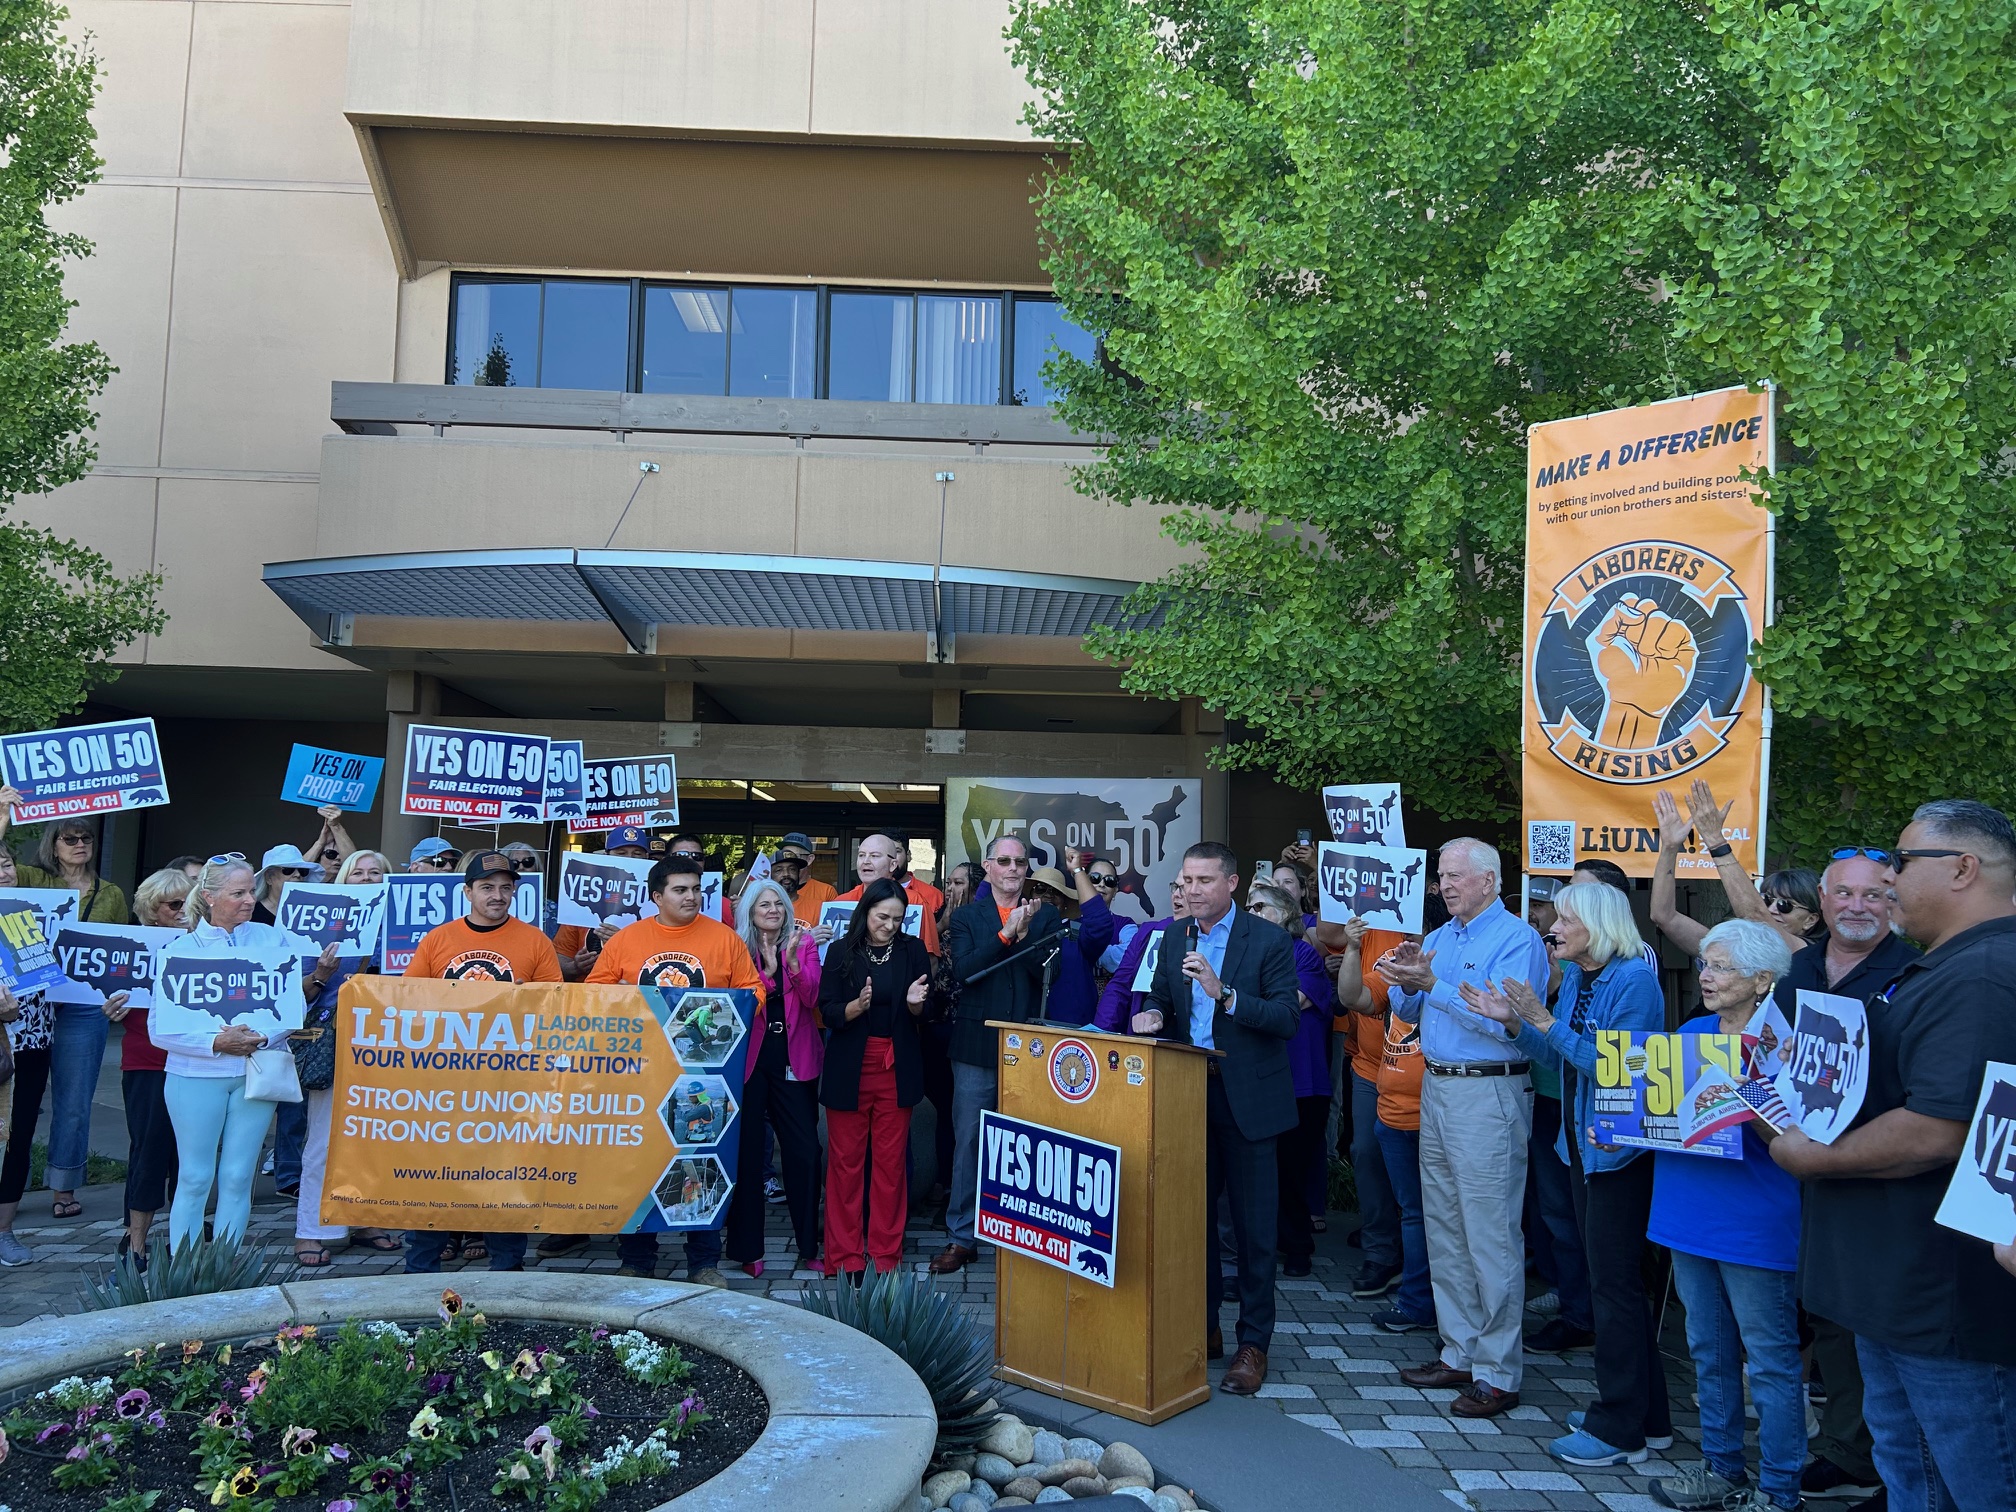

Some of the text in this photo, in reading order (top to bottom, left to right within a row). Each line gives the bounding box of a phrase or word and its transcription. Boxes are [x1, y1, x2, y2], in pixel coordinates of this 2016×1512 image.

[1536, 416, 1762, 488] MAKE A DIFFERENCE
[1539, 502, 1551, 512] by
[1554, 496, 1587, 511] getting
[1590, 486, 1635, 502] involved
[1638, 482, 1659, 494] and
[1663, 476, 1712, 490] building
[1546, 488, 1746, 524] with our union brothers and sisters!
[1578, 548, 1704, 592] LABORERS
[7, 730, 153, 782] YES ON 50
[311, 753, 366, 780] YES ON
[415, 734, 543, 782] YES ON 50
[548, 750, 578, 783] 50
[1574, 738, 1698, 777] RISING
[36, 772, 139, 795] FAIR ELECTIONS
[298, 774, 364, 802] PROP 50
[428, 780, 523, 796] FAIR ELECTIONS
[583, 763, 671, 798] ES ON 50
[18, 794, 118, 818] VOTE NOV. 4TH
[409, 797, 498, 815] VOTE NOV. 4TH
[586, 798, 659, 811] FAIR ELECTIONS
[573, 814, 642, 828] VOTE NOV. 4TH
[1347, 810, 1359, 821] ON
[1363, 807, 1388, 834] 50
[971, 818, 1160, 876] YS ON 50
[1582, 826, 1695, 854] LiUN!
[1679, 858, 1694, 868] the
[567, 874, 603, 902] YES
[606, 880, 621, 893] ON
[1324, 866, 1409, 901] YES ON 50
[287, 904, 372, 932] YES ON 50
[391, 882, 536, 926] YES O 0
[58, 946, 107, 978] YES
[112, 951, 129, 964] ON
[460, 952, 502, 964] LABORERS
[653, 954, 693, 963] LABORERS
[168, 971, 284, 1003] YES ON 50
[351, 1006, 536, 1052] LiUNA!
[538, 1015, 644, 1033] LABORERS
[536, 1034, 642, 1053] LOCAL 324
[351, 1047, 405, 1068] YOUR
[411, 1051, 540, 1072] WORKFORCE
[1790, 1032, 1857, 1096] YES ON 50
[347, 1085, 645, 1116] STRONG UNIONS BUILD
[343, 1115, 643, 1146] STRONG COMMUNITIES
[1979, 1114, 2016, 1182] YE
[394, 1166, 577, 1185] www.liunalocal324.org
[987, 1125, 1112, 1217] YES ON 50
[330, 1194, 353, 1204] Serving
[355, 1197, 378, 1205] Contra
[543, 1202, 576, 1210] Humboldt,
[1000, 1193, 1091, 1237] FAIR ELECTIONS
[982, 1215, 1068, 1260] VOTE NOV. 4TH
